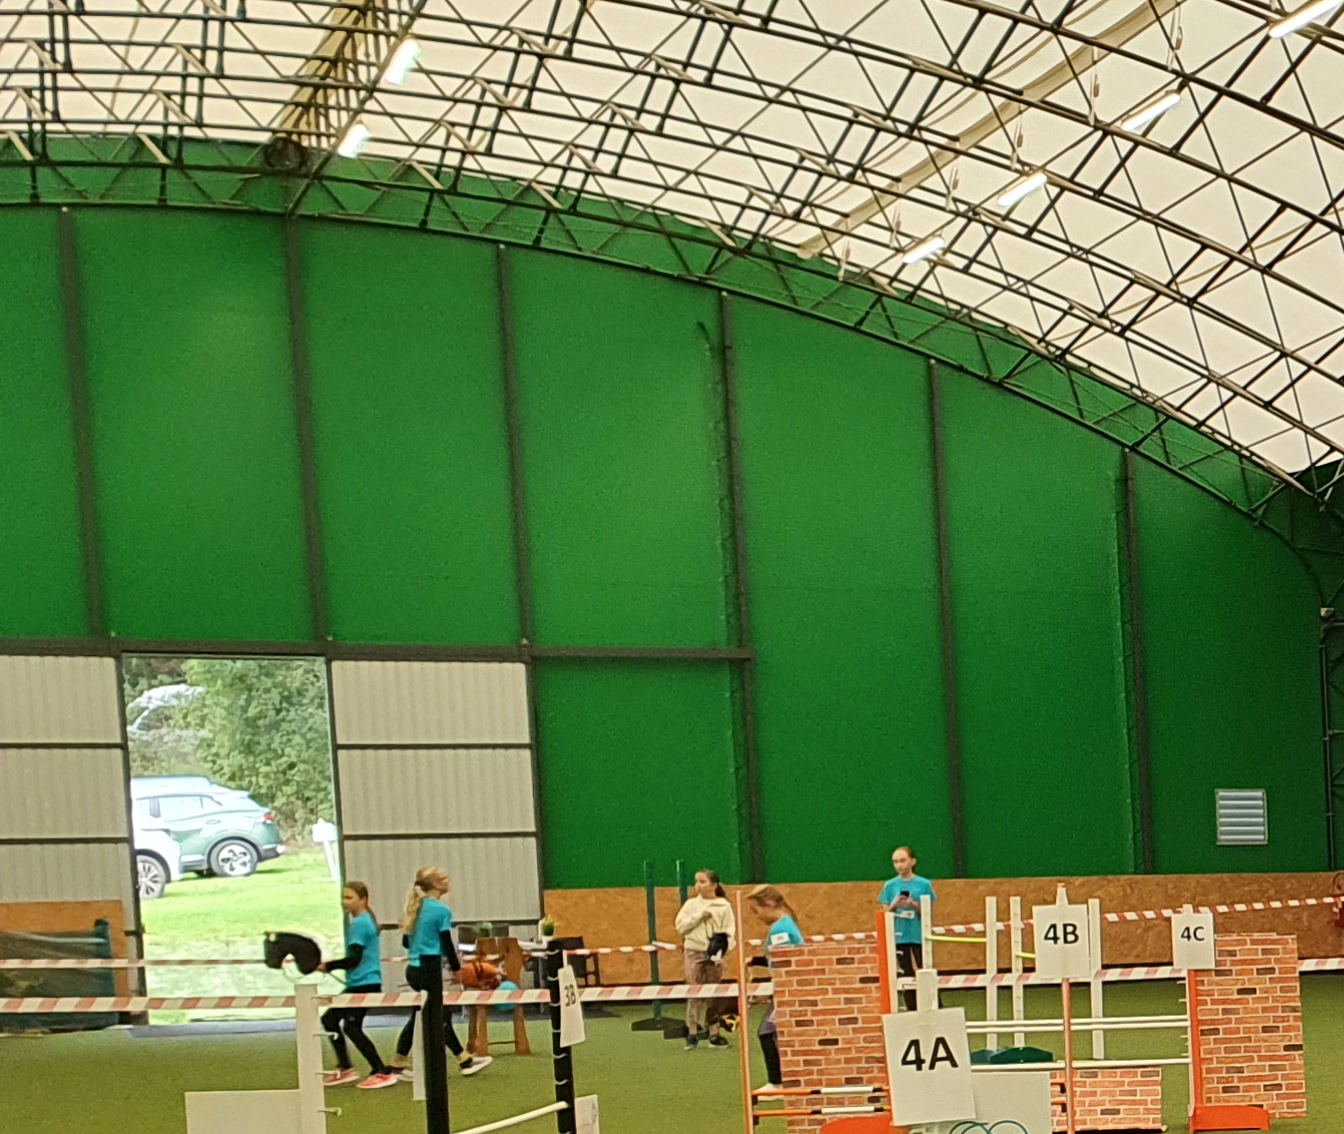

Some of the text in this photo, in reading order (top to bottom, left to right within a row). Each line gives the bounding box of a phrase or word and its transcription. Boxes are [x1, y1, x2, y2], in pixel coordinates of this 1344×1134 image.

[1043, 922, 1080, 946] 4B
[1180, 925, 1205, 942] 4C
[900, 1036, 960, 1072] 4A
